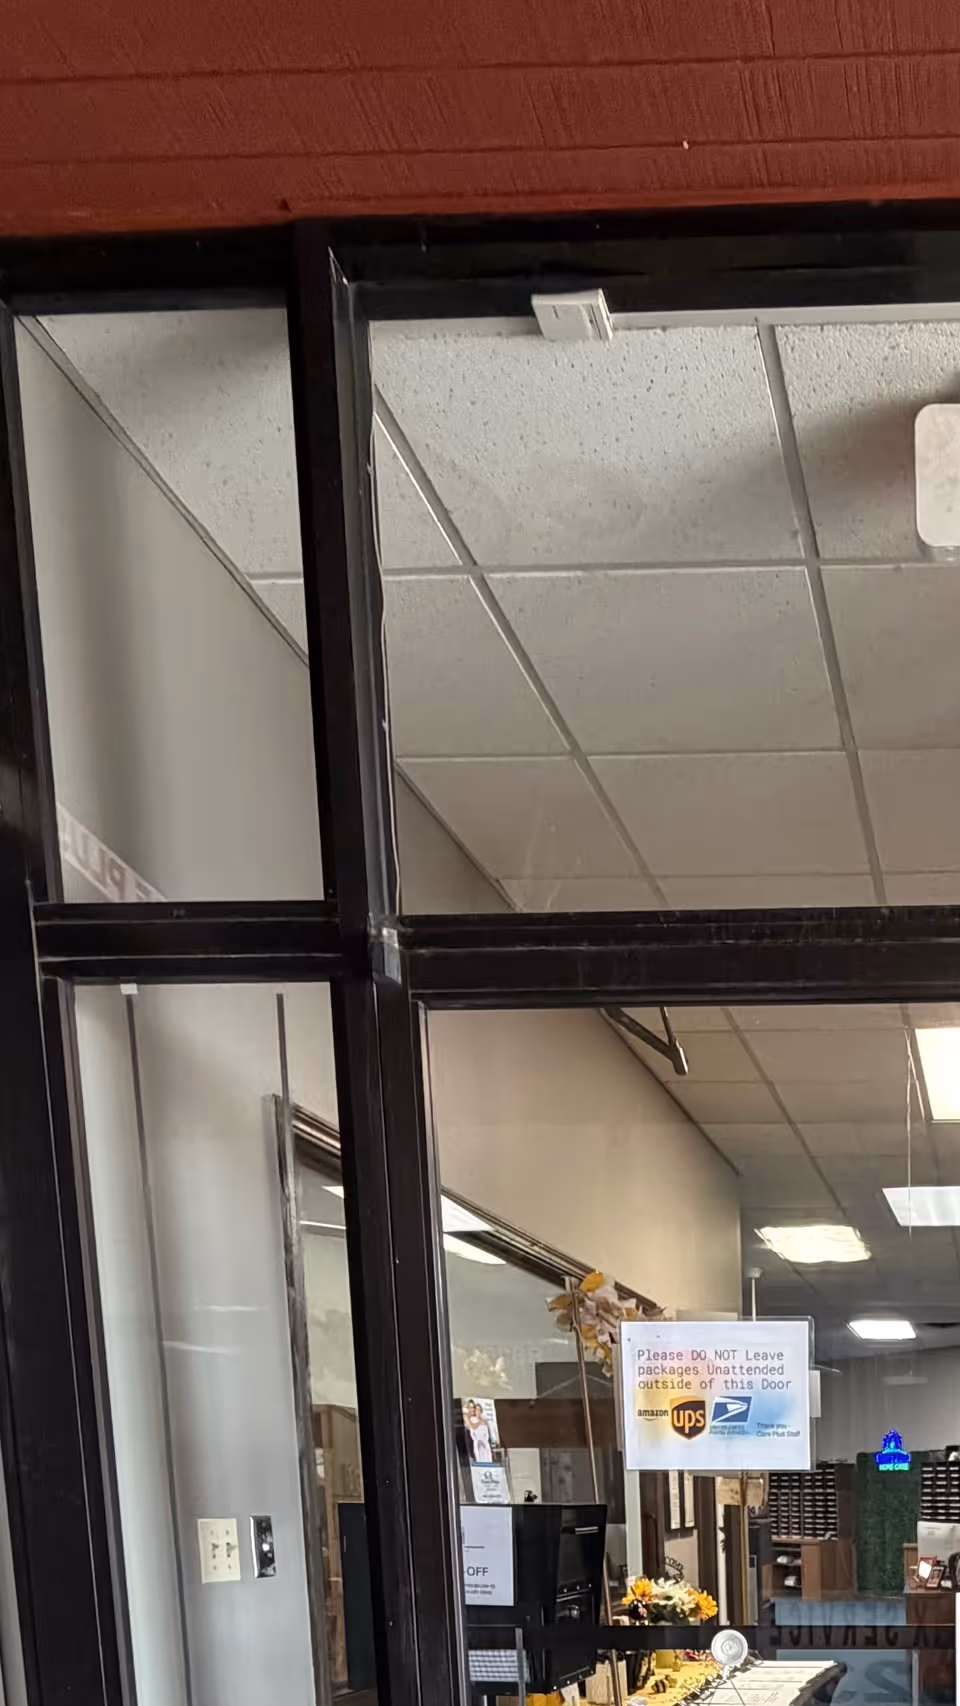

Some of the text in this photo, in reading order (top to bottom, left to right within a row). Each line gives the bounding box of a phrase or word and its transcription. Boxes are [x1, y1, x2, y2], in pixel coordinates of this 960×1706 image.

[637, 1349, 785, 1361] Please DO NOT Leave
[637, 1364, 785, 1377] packages Unattended
[638, 1378, 792, 1390] outside of this Door
[637, 1409, 669, 1418] amazon
[673, 1409, 705, 1434] ups
